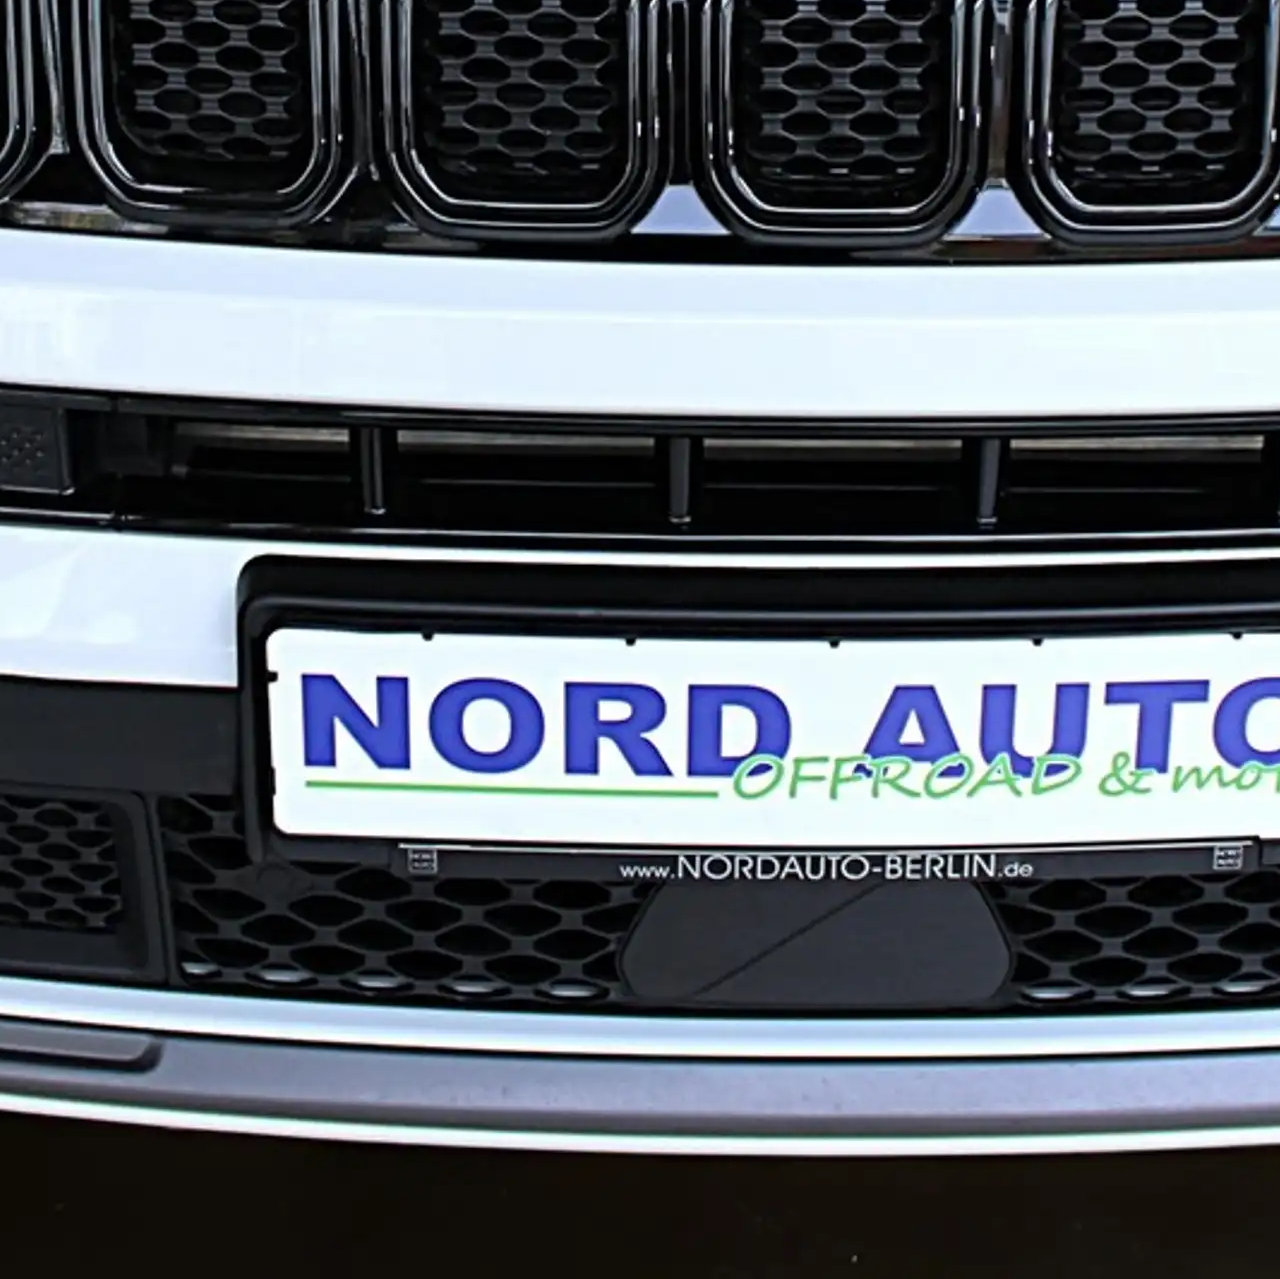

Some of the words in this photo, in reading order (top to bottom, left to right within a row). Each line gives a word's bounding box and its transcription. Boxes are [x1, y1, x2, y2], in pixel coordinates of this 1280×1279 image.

[300, 673, 792, 778] NORD
[732, 752, 1083, 800] OFFROAD
[1098, 751, 1154, 798] &
[619, 853, 1034, 881] www.NORDAUTO-BERLIN.de
